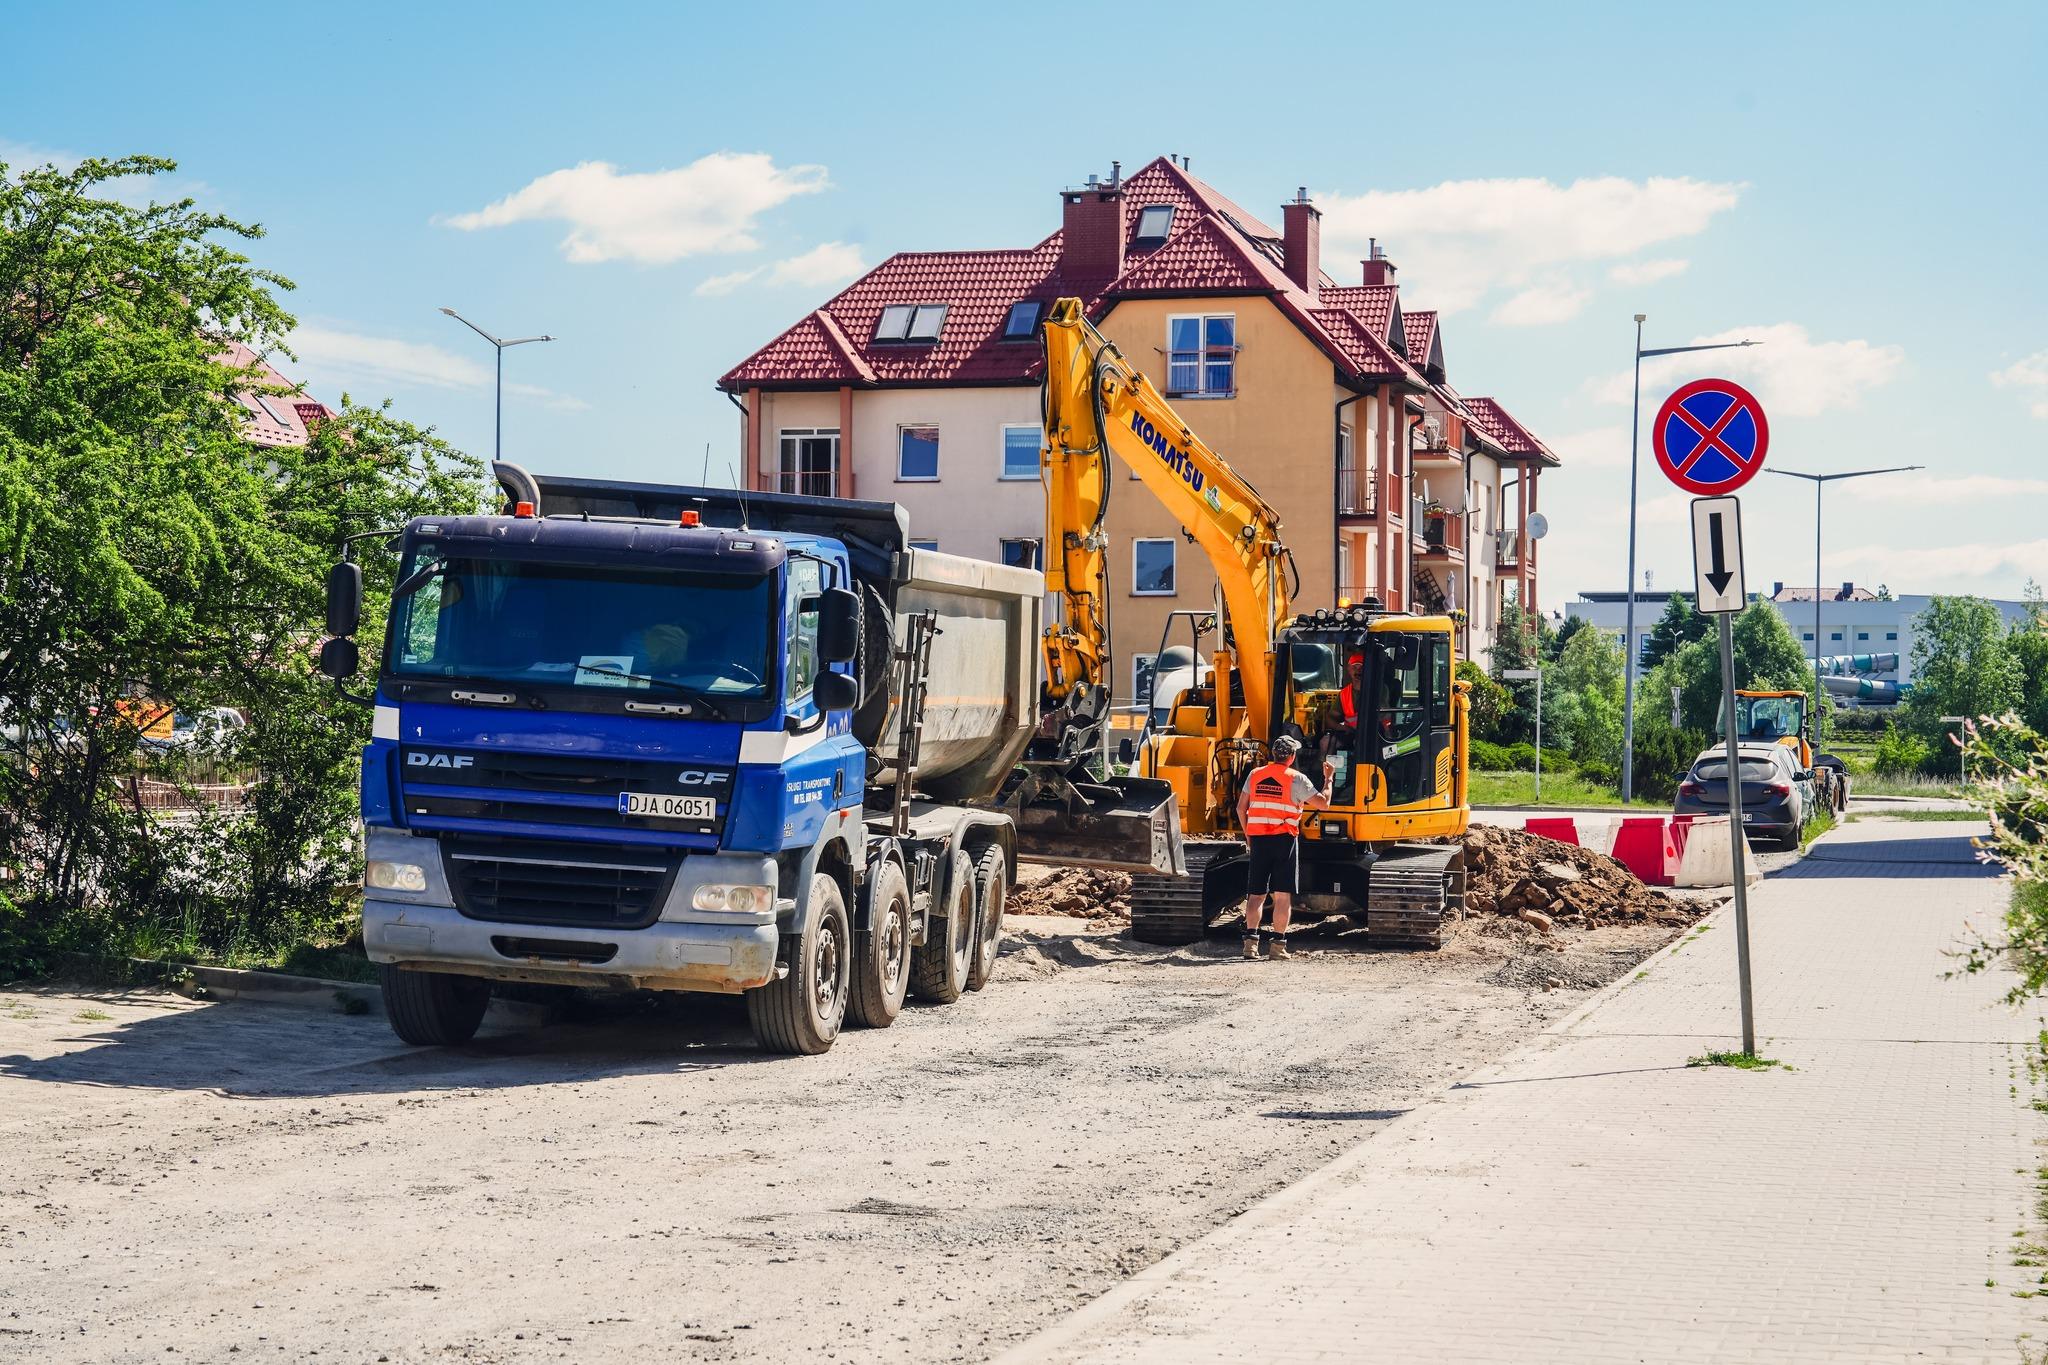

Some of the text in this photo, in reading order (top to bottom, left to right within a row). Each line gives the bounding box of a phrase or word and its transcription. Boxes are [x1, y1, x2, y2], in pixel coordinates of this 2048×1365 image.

[1130, 409, 1204, 492] KOMATSU
[407, 752, 474, 768] DAF
[678, 770, 730, 785] CF
[629, 796, 659, 814] DJA
[664, 798, 711, 817] 06051
